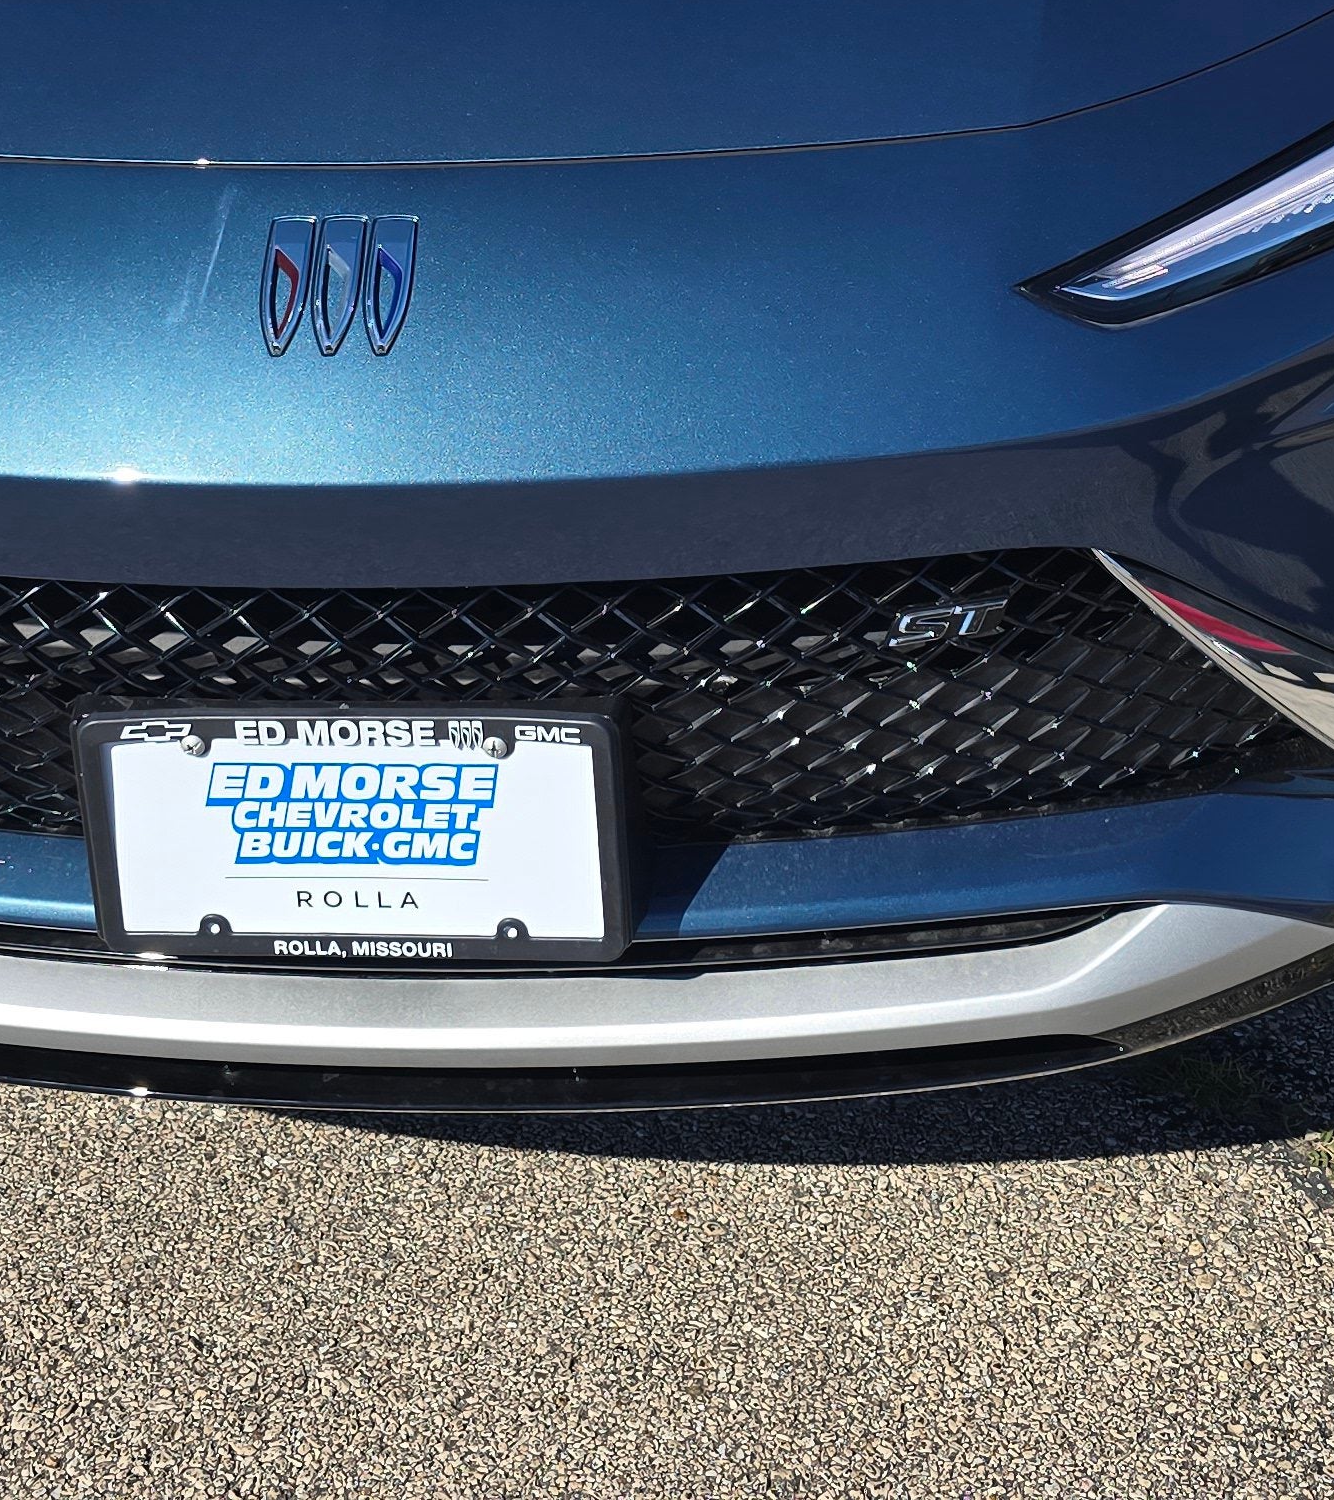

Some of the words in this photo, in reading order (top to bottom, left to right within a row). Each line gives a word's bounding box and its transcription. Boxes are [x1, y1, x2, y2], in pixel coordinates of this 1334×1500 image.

[234, 719, 287, 746] ED
[296, 719, 436, 747] MORSE
[514, 725, 581, 744] GMC
[208, 764, 285, 799] ED
[290, 764, 496, 800] MORSE
[233, 801, 476, 829] CHEVROLET
[296, 890, 419, 909] ROLLA
[273, 940, 348, 959] ROLLA,
[351, 941, 453, 958] MISSOURI
